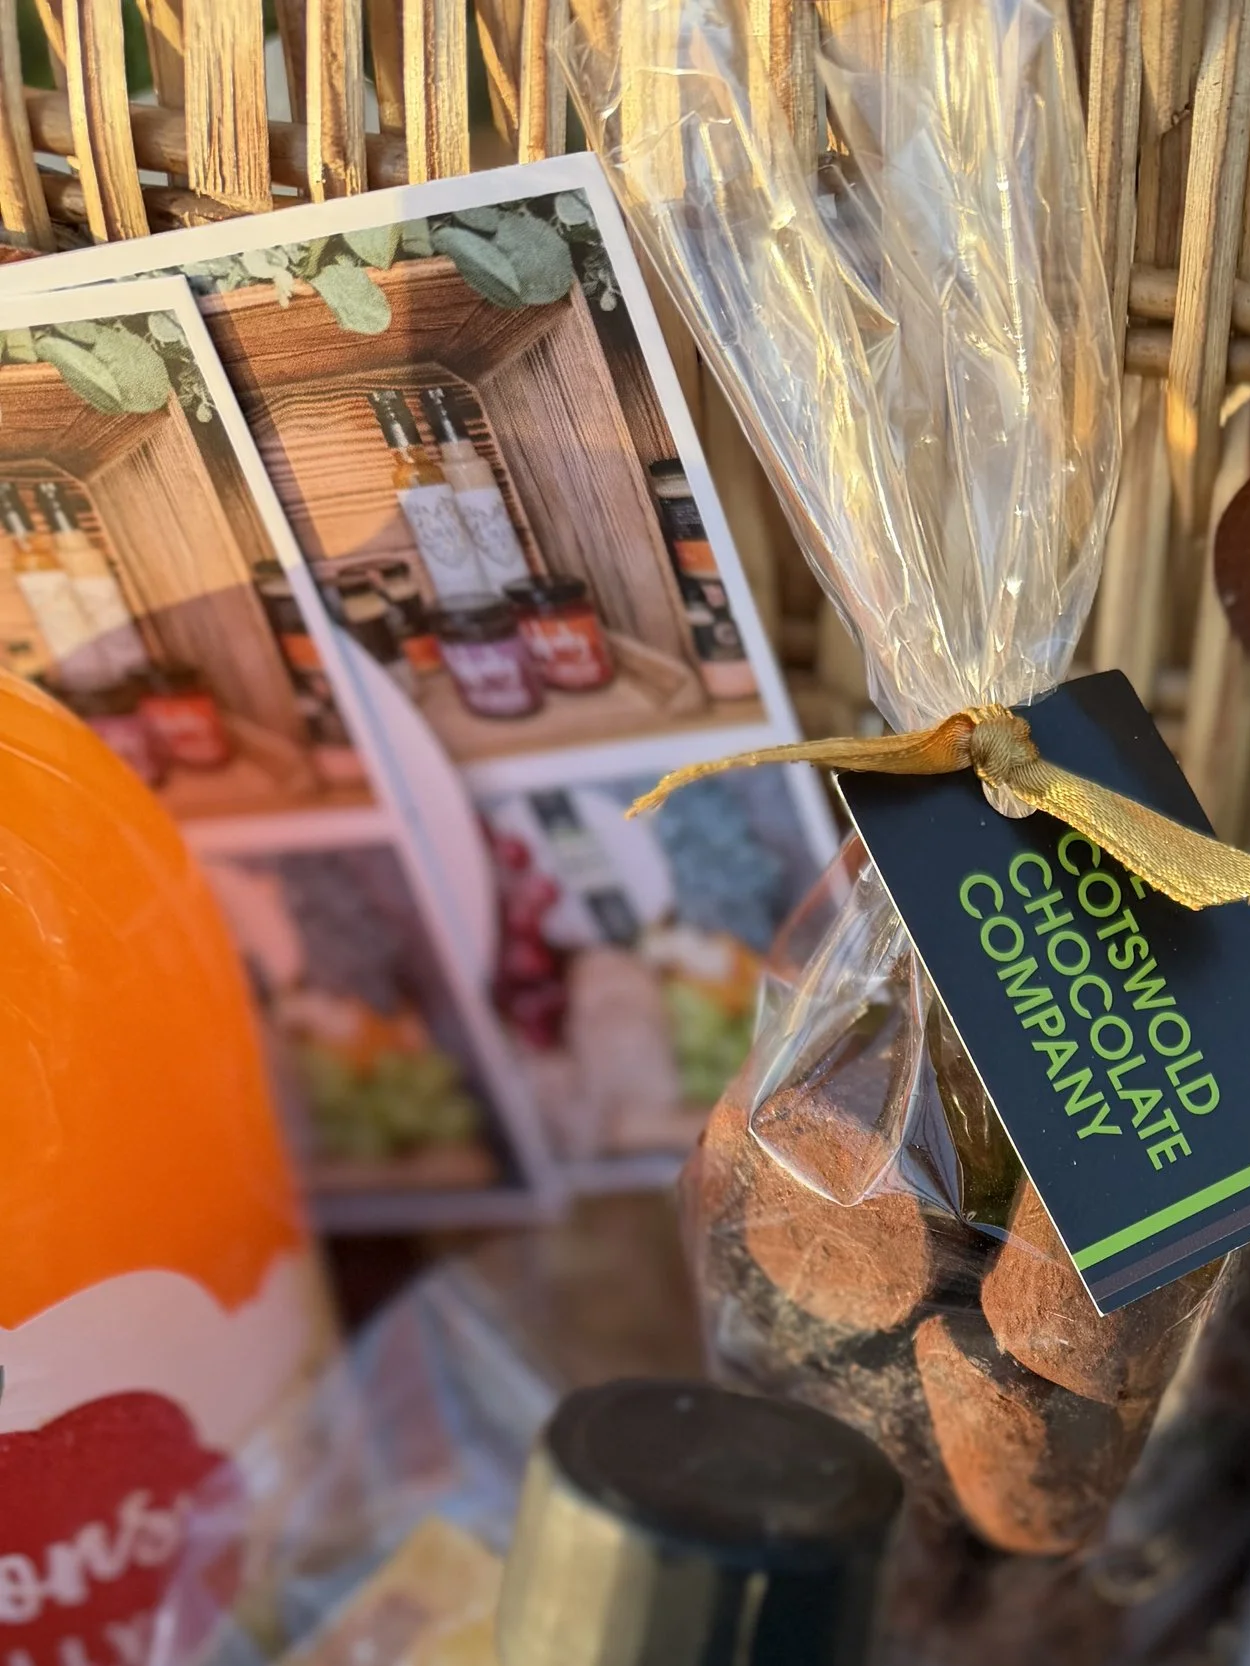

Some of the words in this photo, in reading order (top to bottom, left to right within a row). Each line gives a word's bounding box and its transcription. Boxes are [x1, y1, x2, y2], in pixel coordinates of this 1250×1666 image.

[959, 873, 1122, 1140] COMPANY
[1009, 852, 1192, 1171] CHOCOLATE
[1057, 831, 1220, 1116] COTSWOLD
